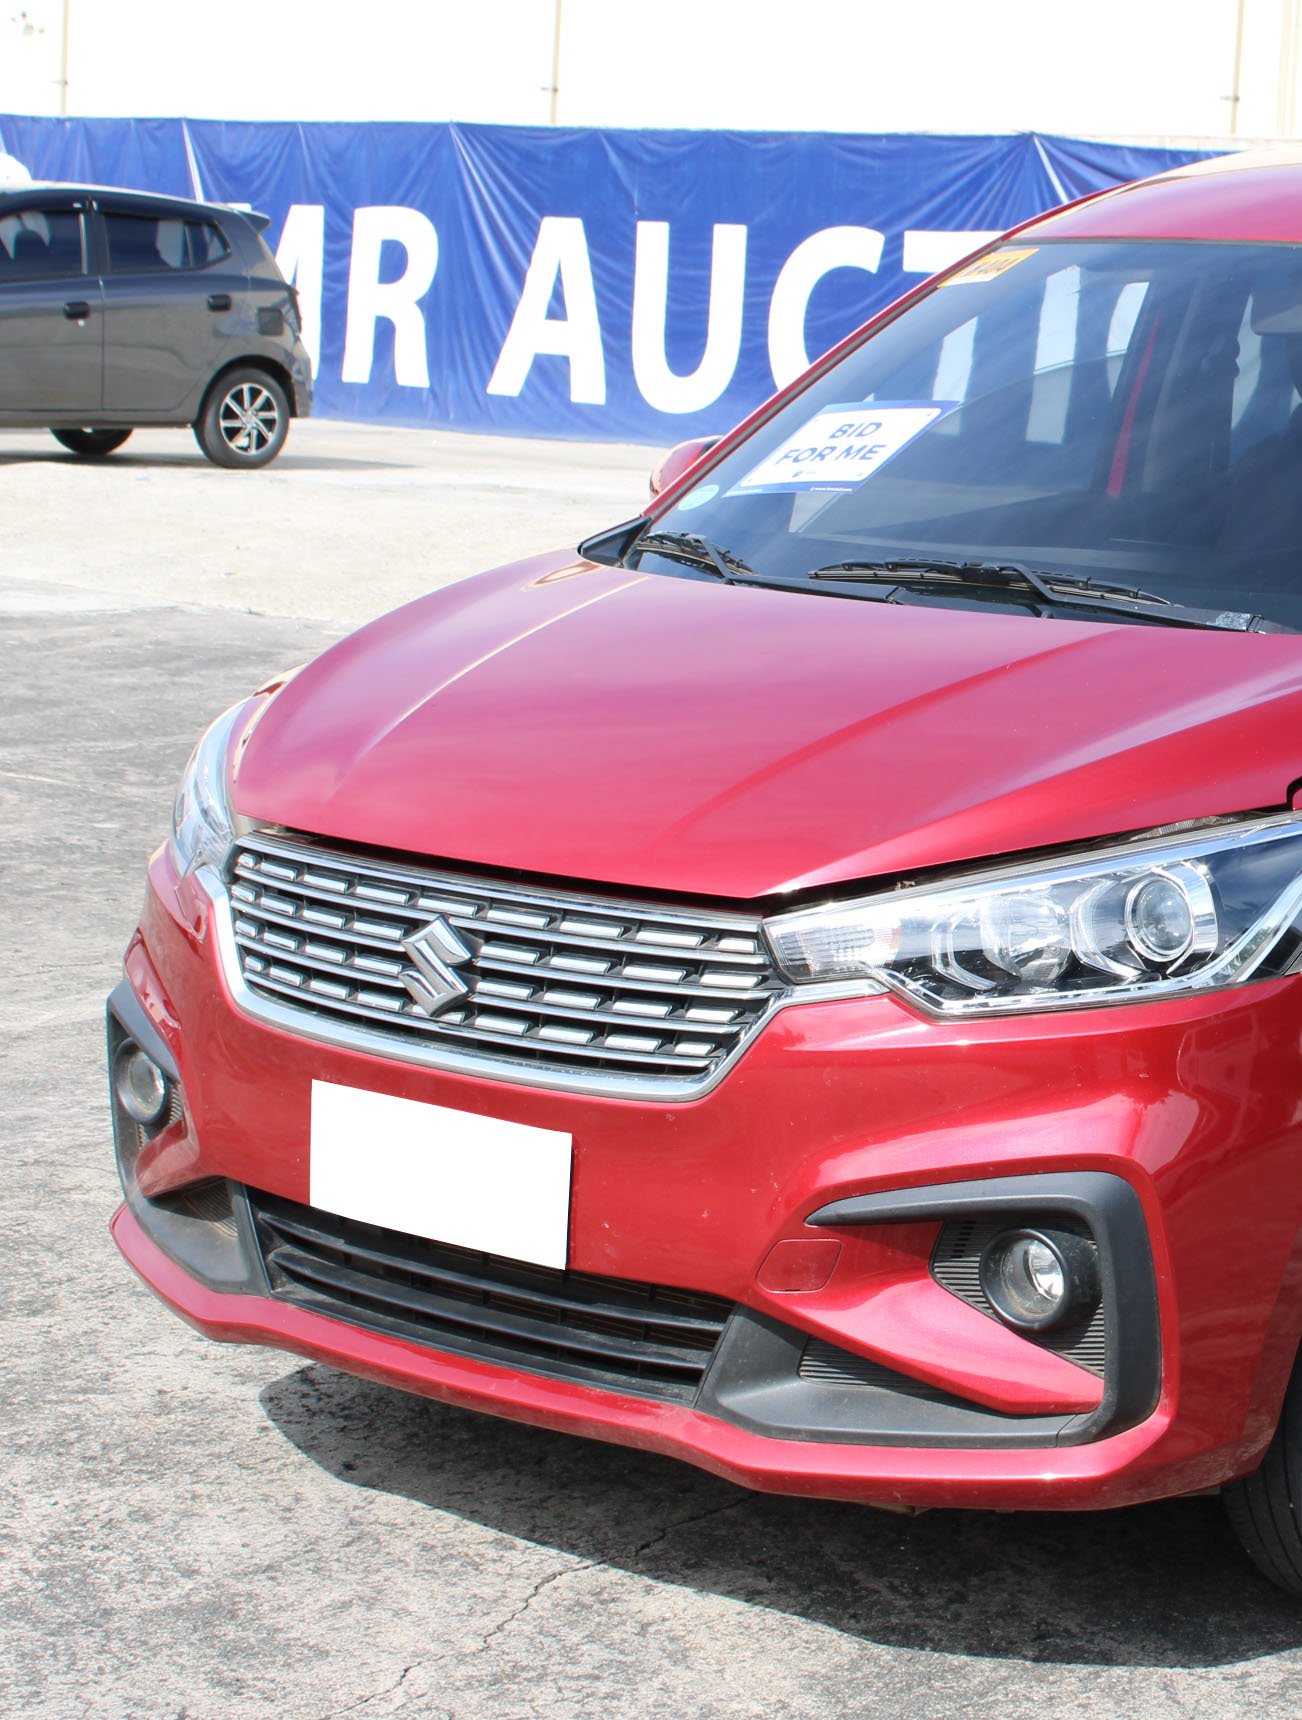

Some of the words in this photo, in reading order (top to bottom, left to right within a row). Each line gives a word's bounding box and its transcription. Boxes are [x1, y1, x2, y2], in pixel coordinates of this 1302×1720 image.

[827, 422, 883, 439] BID
[775, 446, 838, 465] FOR
[834, 444, 888, 462] ME
